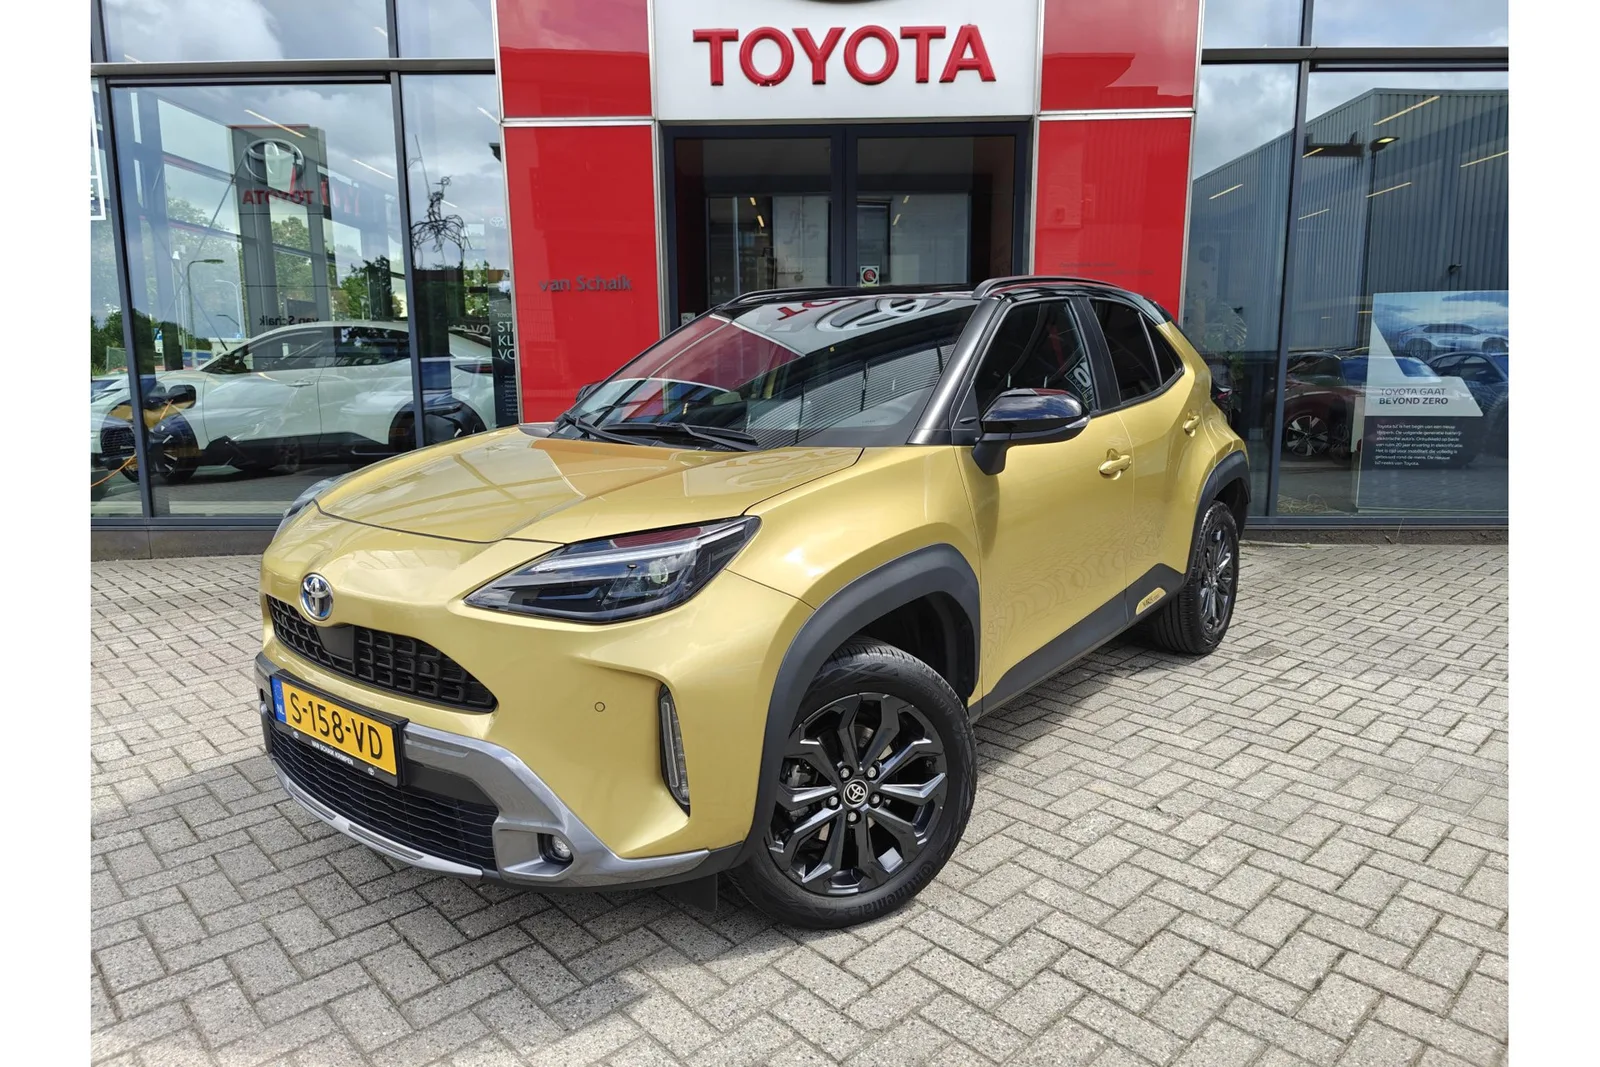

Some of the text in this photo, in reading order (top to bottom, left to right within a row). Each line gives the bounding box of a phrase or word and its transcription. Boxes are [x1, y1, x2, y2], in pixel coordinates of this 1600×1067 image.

[693, 25, 996, 87] TOYOTA
[539, 274, 632, 291] van Schaik
[497, 321, 514, 332] ST
[1379, 397, 1449, 405] BEYOND ZERO
[276, 704, 285, 716] NL
[290, 692, 383, 760] S-158-VD
[858, 860, 937, 916] Continental
